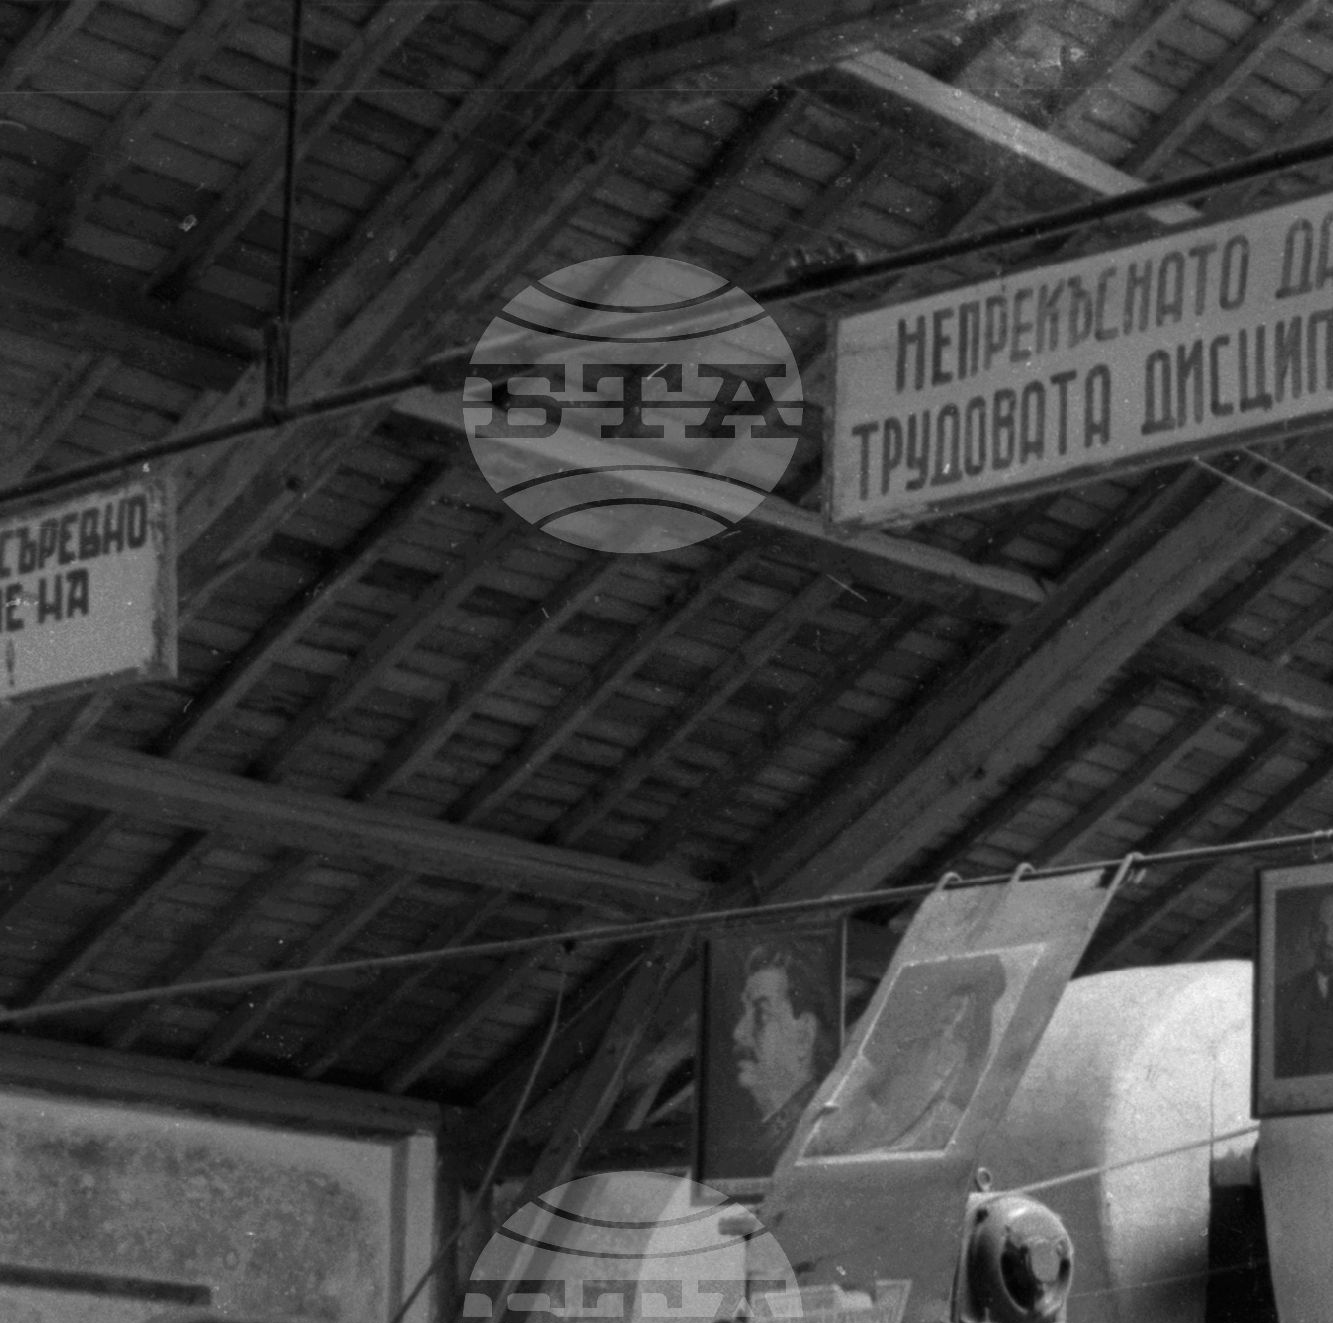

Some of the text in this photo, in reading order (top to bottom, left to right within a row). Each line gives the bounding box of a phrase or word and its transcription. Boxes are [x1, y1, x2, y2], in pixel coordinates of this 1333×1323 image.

[894, 234, 1252, 394] НЕПРЕКЪСНАТО
[851, 363, 1114, 501] ТРУДОВАТА
[38, 567, 90, 624] НА
